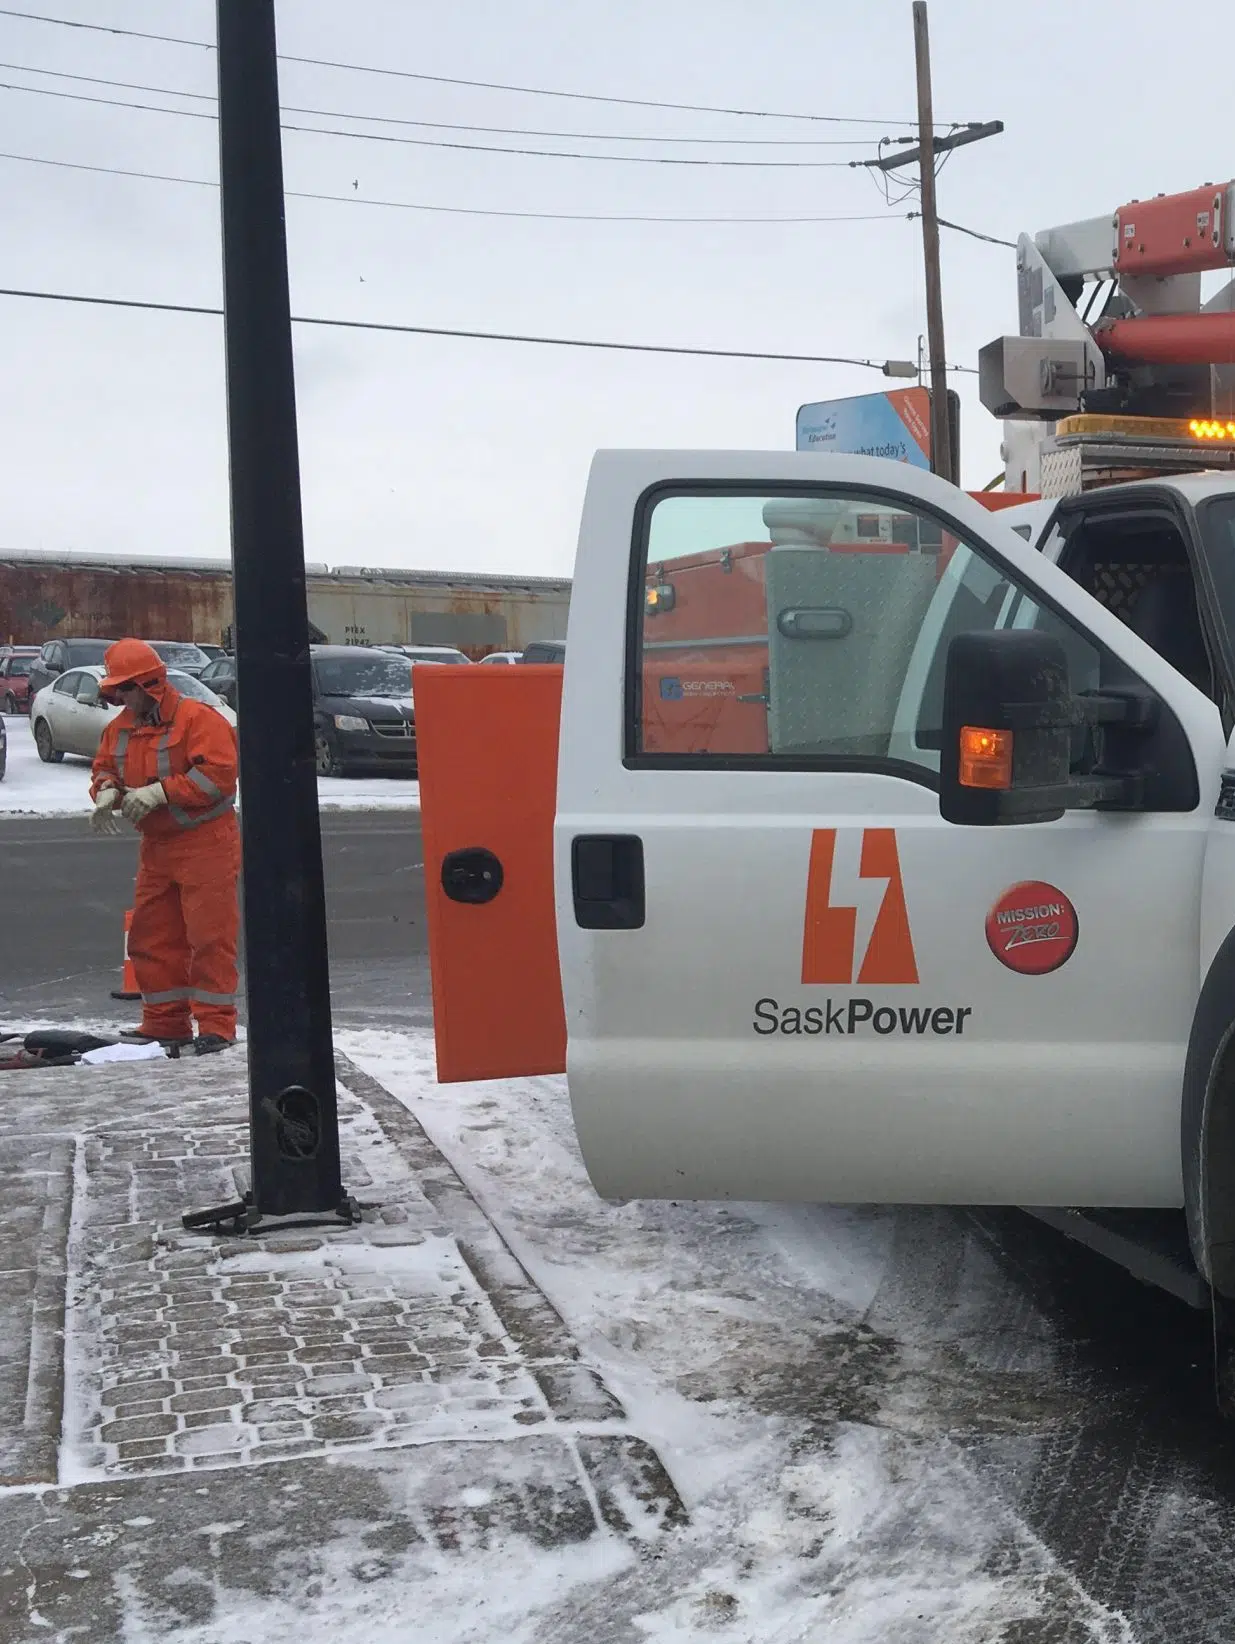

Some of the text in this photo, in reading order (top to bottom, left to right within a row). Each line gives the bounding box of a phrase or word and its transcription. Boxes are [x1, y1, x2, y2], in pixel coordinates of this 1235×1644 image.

[876, 442, 906, 457] today's
[682, 681, 735, 690] GENERAL
[996, 902, 1065, 924] MISSION:
[753, 997, 972, 1035] SaskPower
